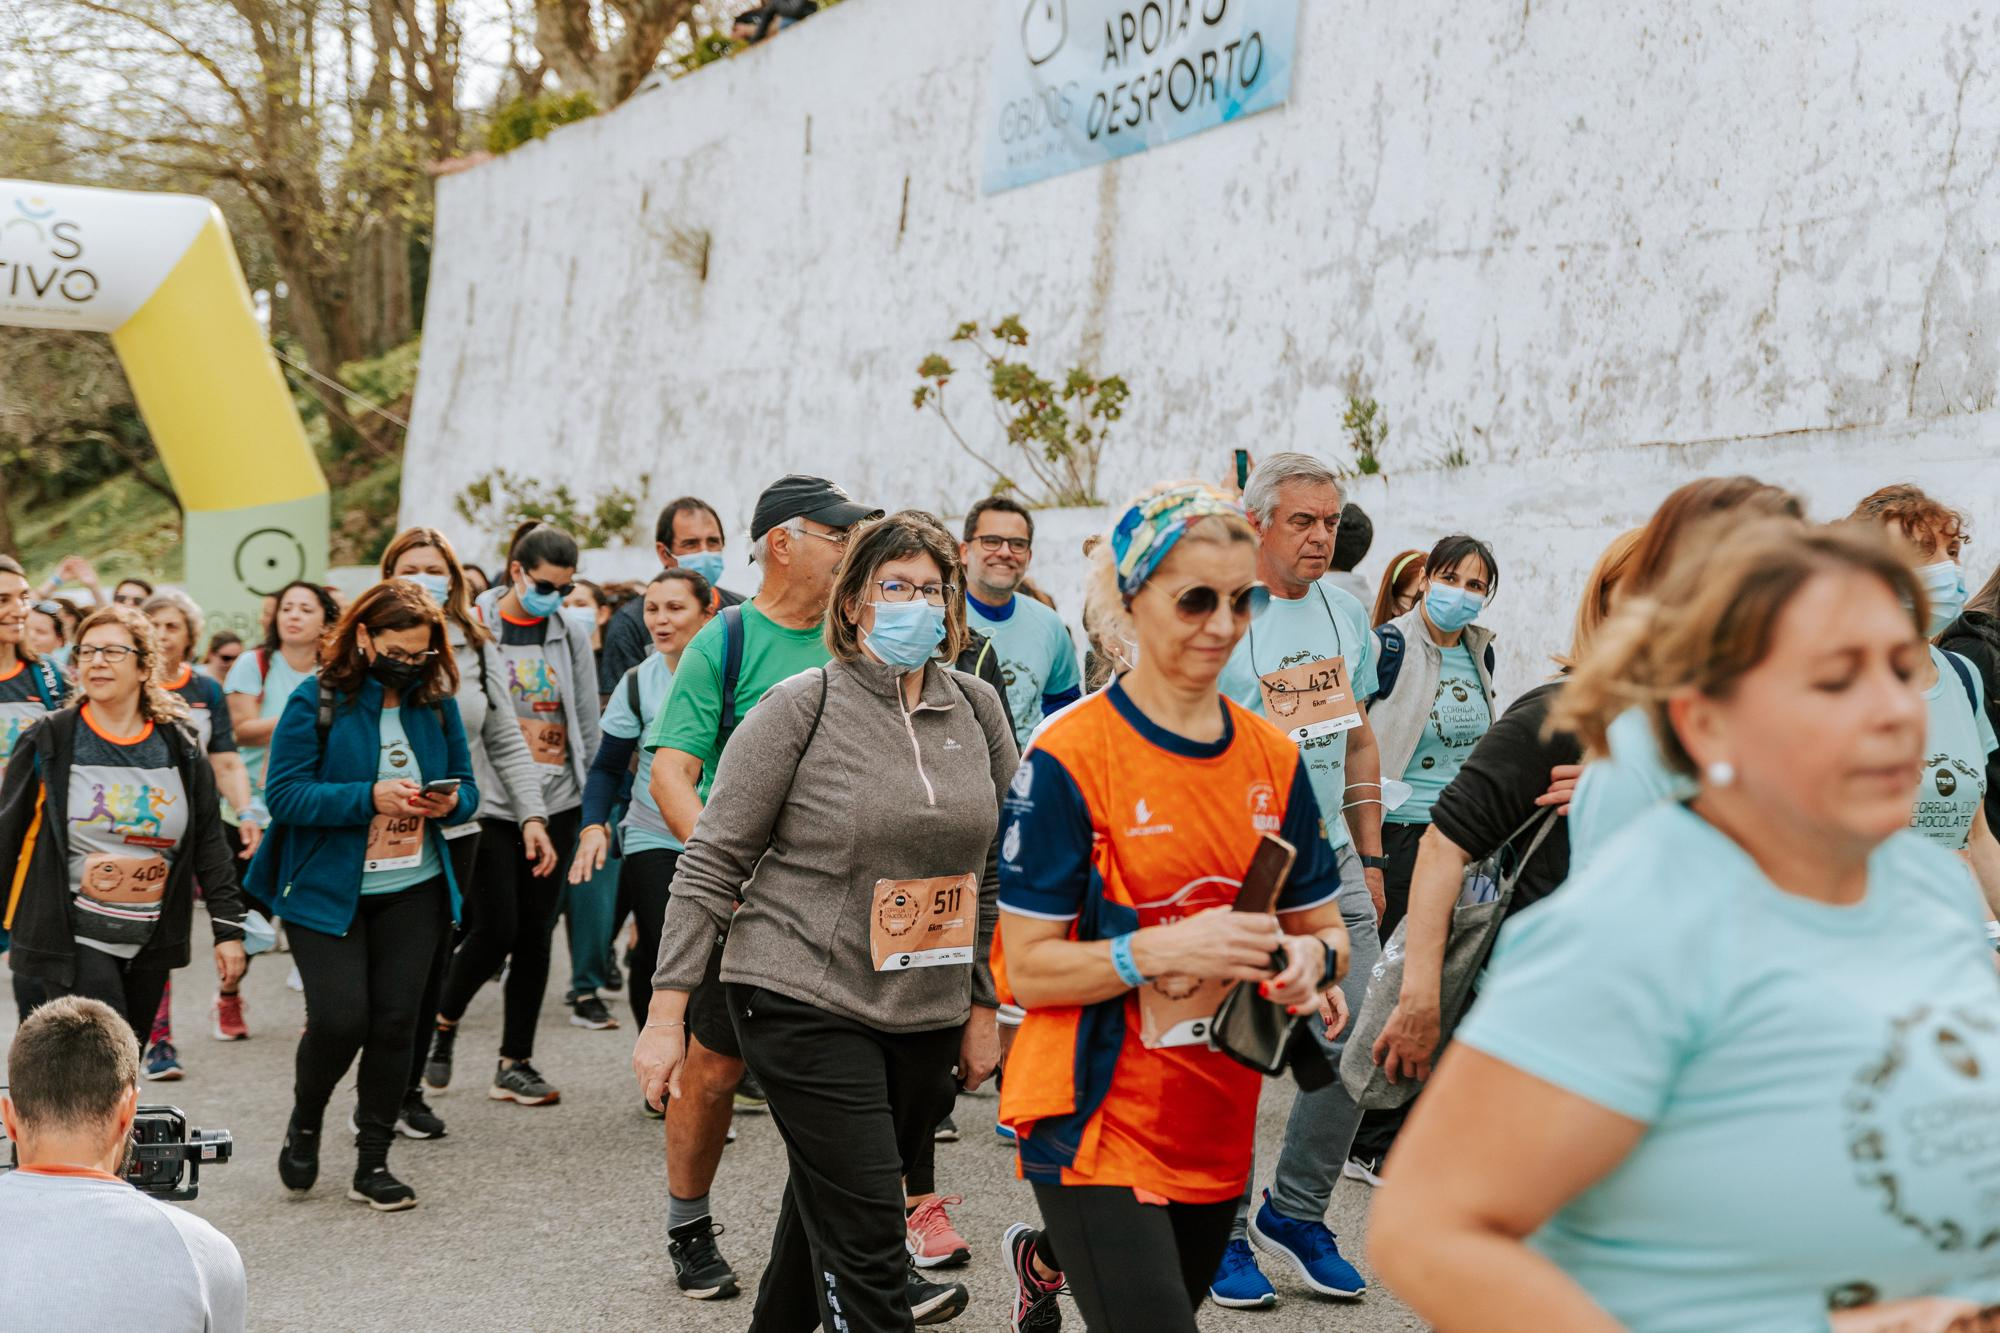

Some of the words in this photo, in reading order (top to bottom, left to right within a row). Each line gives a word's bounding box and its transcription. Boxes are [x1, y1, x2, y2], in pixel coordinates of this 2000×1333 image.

[1087, 31, 1263, 140] DESPORTO
[1309, 668, 1340, 691] 421
[1312, 699, 1326, 708] 6km
[1911, 801, 1958, 814] CORRIDA
[386, 816, 418, 834] 460
[1909, 815, 1971, 828] CHOCOLATE
[933, 887, 961, 914] 511
[928, 923, 943, 932] 6km
